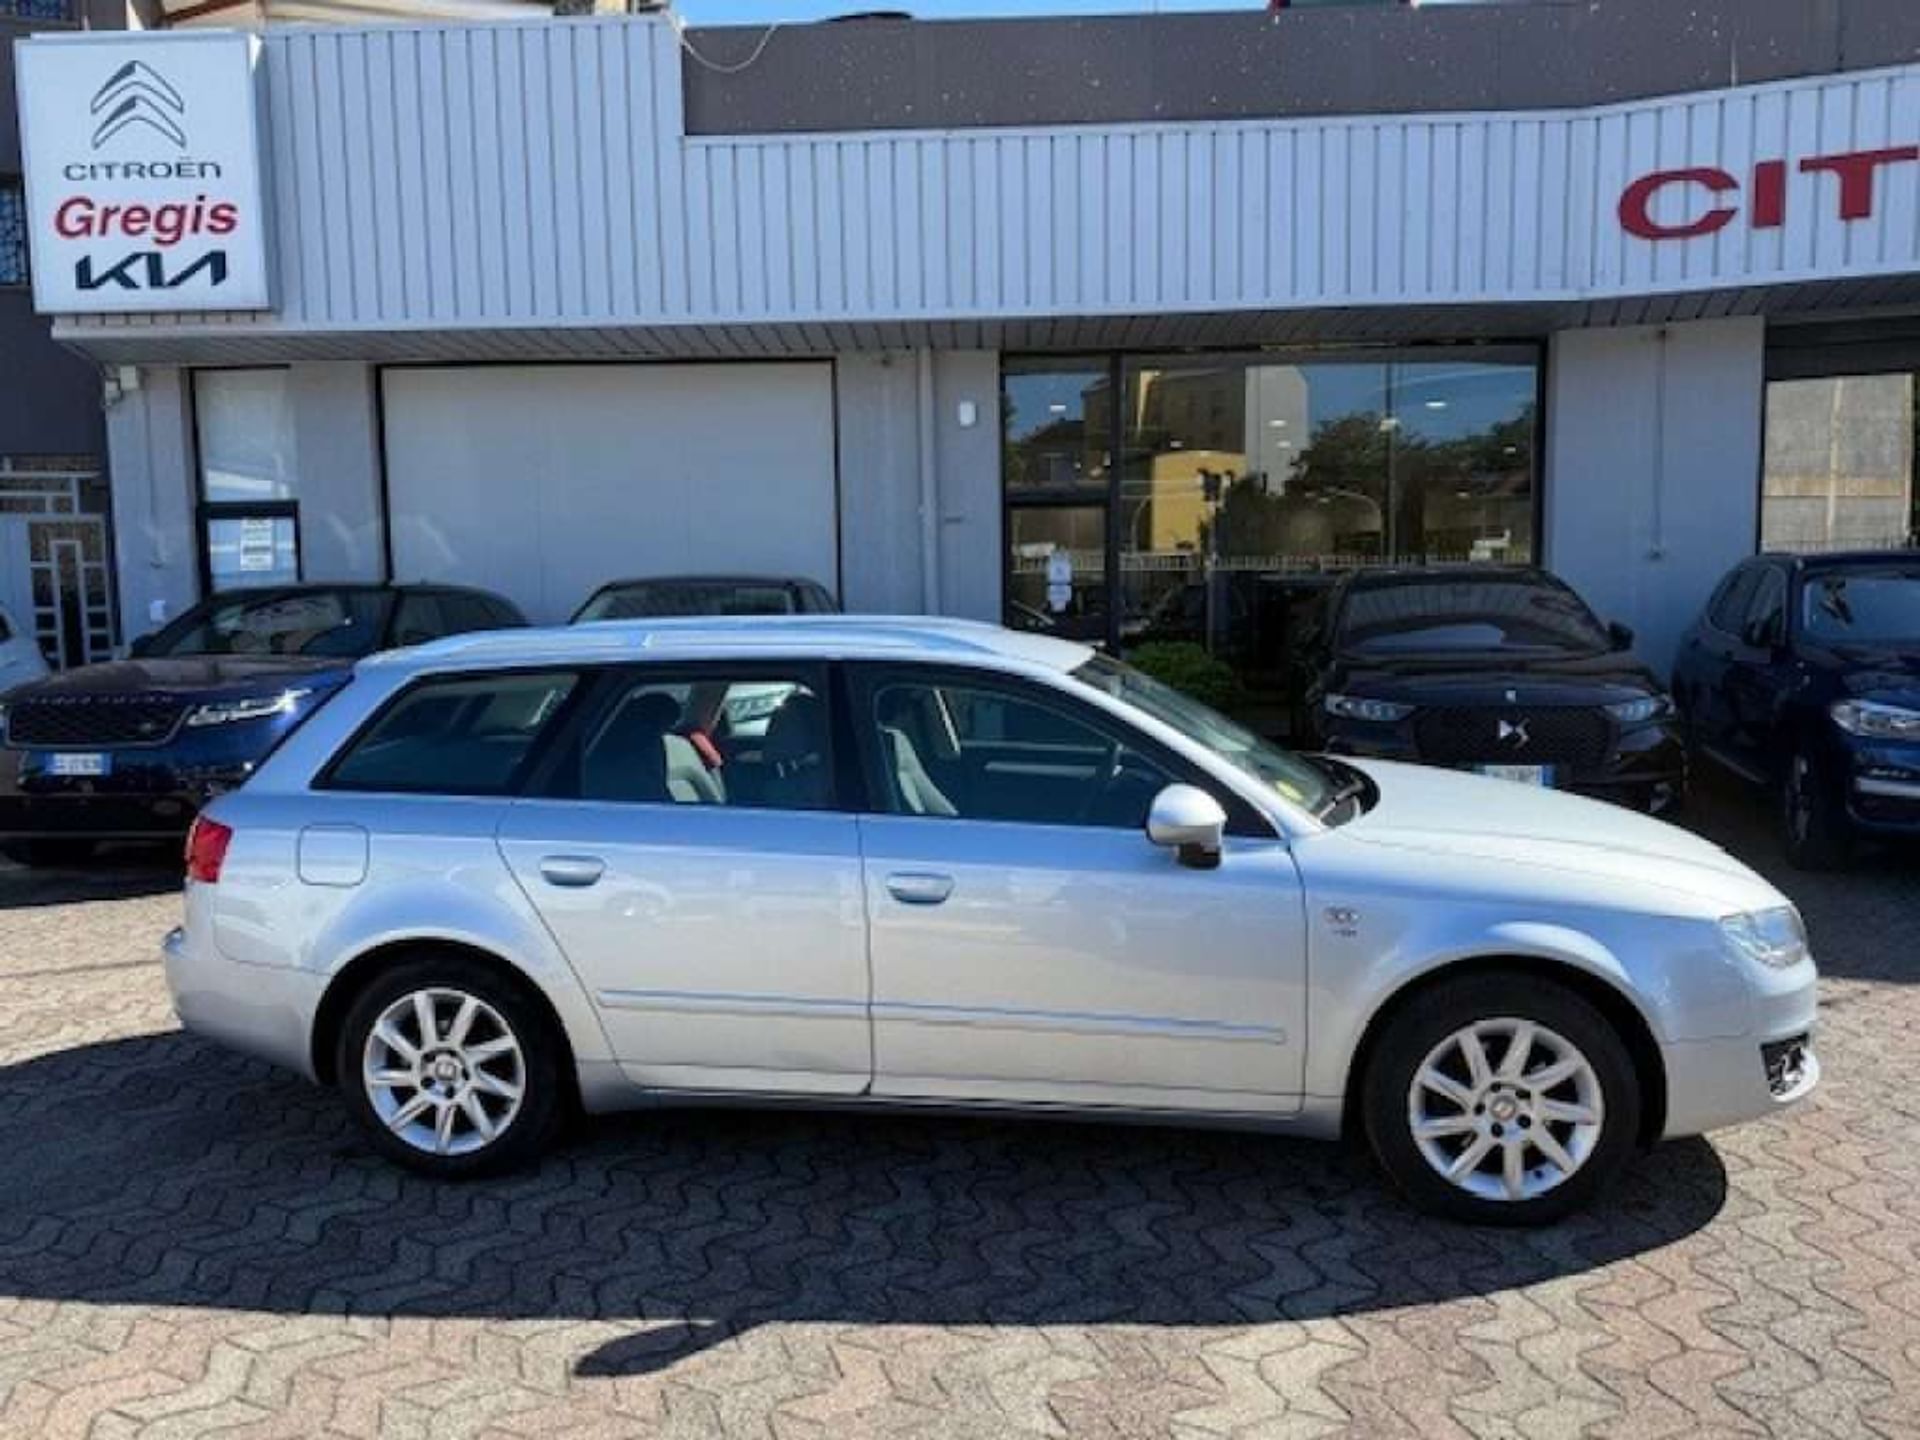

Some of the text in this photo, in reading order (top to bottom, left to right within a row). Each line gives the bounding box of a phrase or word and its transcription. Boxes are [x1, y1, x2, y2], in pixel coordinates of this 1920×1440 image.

[1618, 145, 1919, 240] CIT
[54, 195, 239, 246] Gregis
[75, 250, 227, 290] KIA
